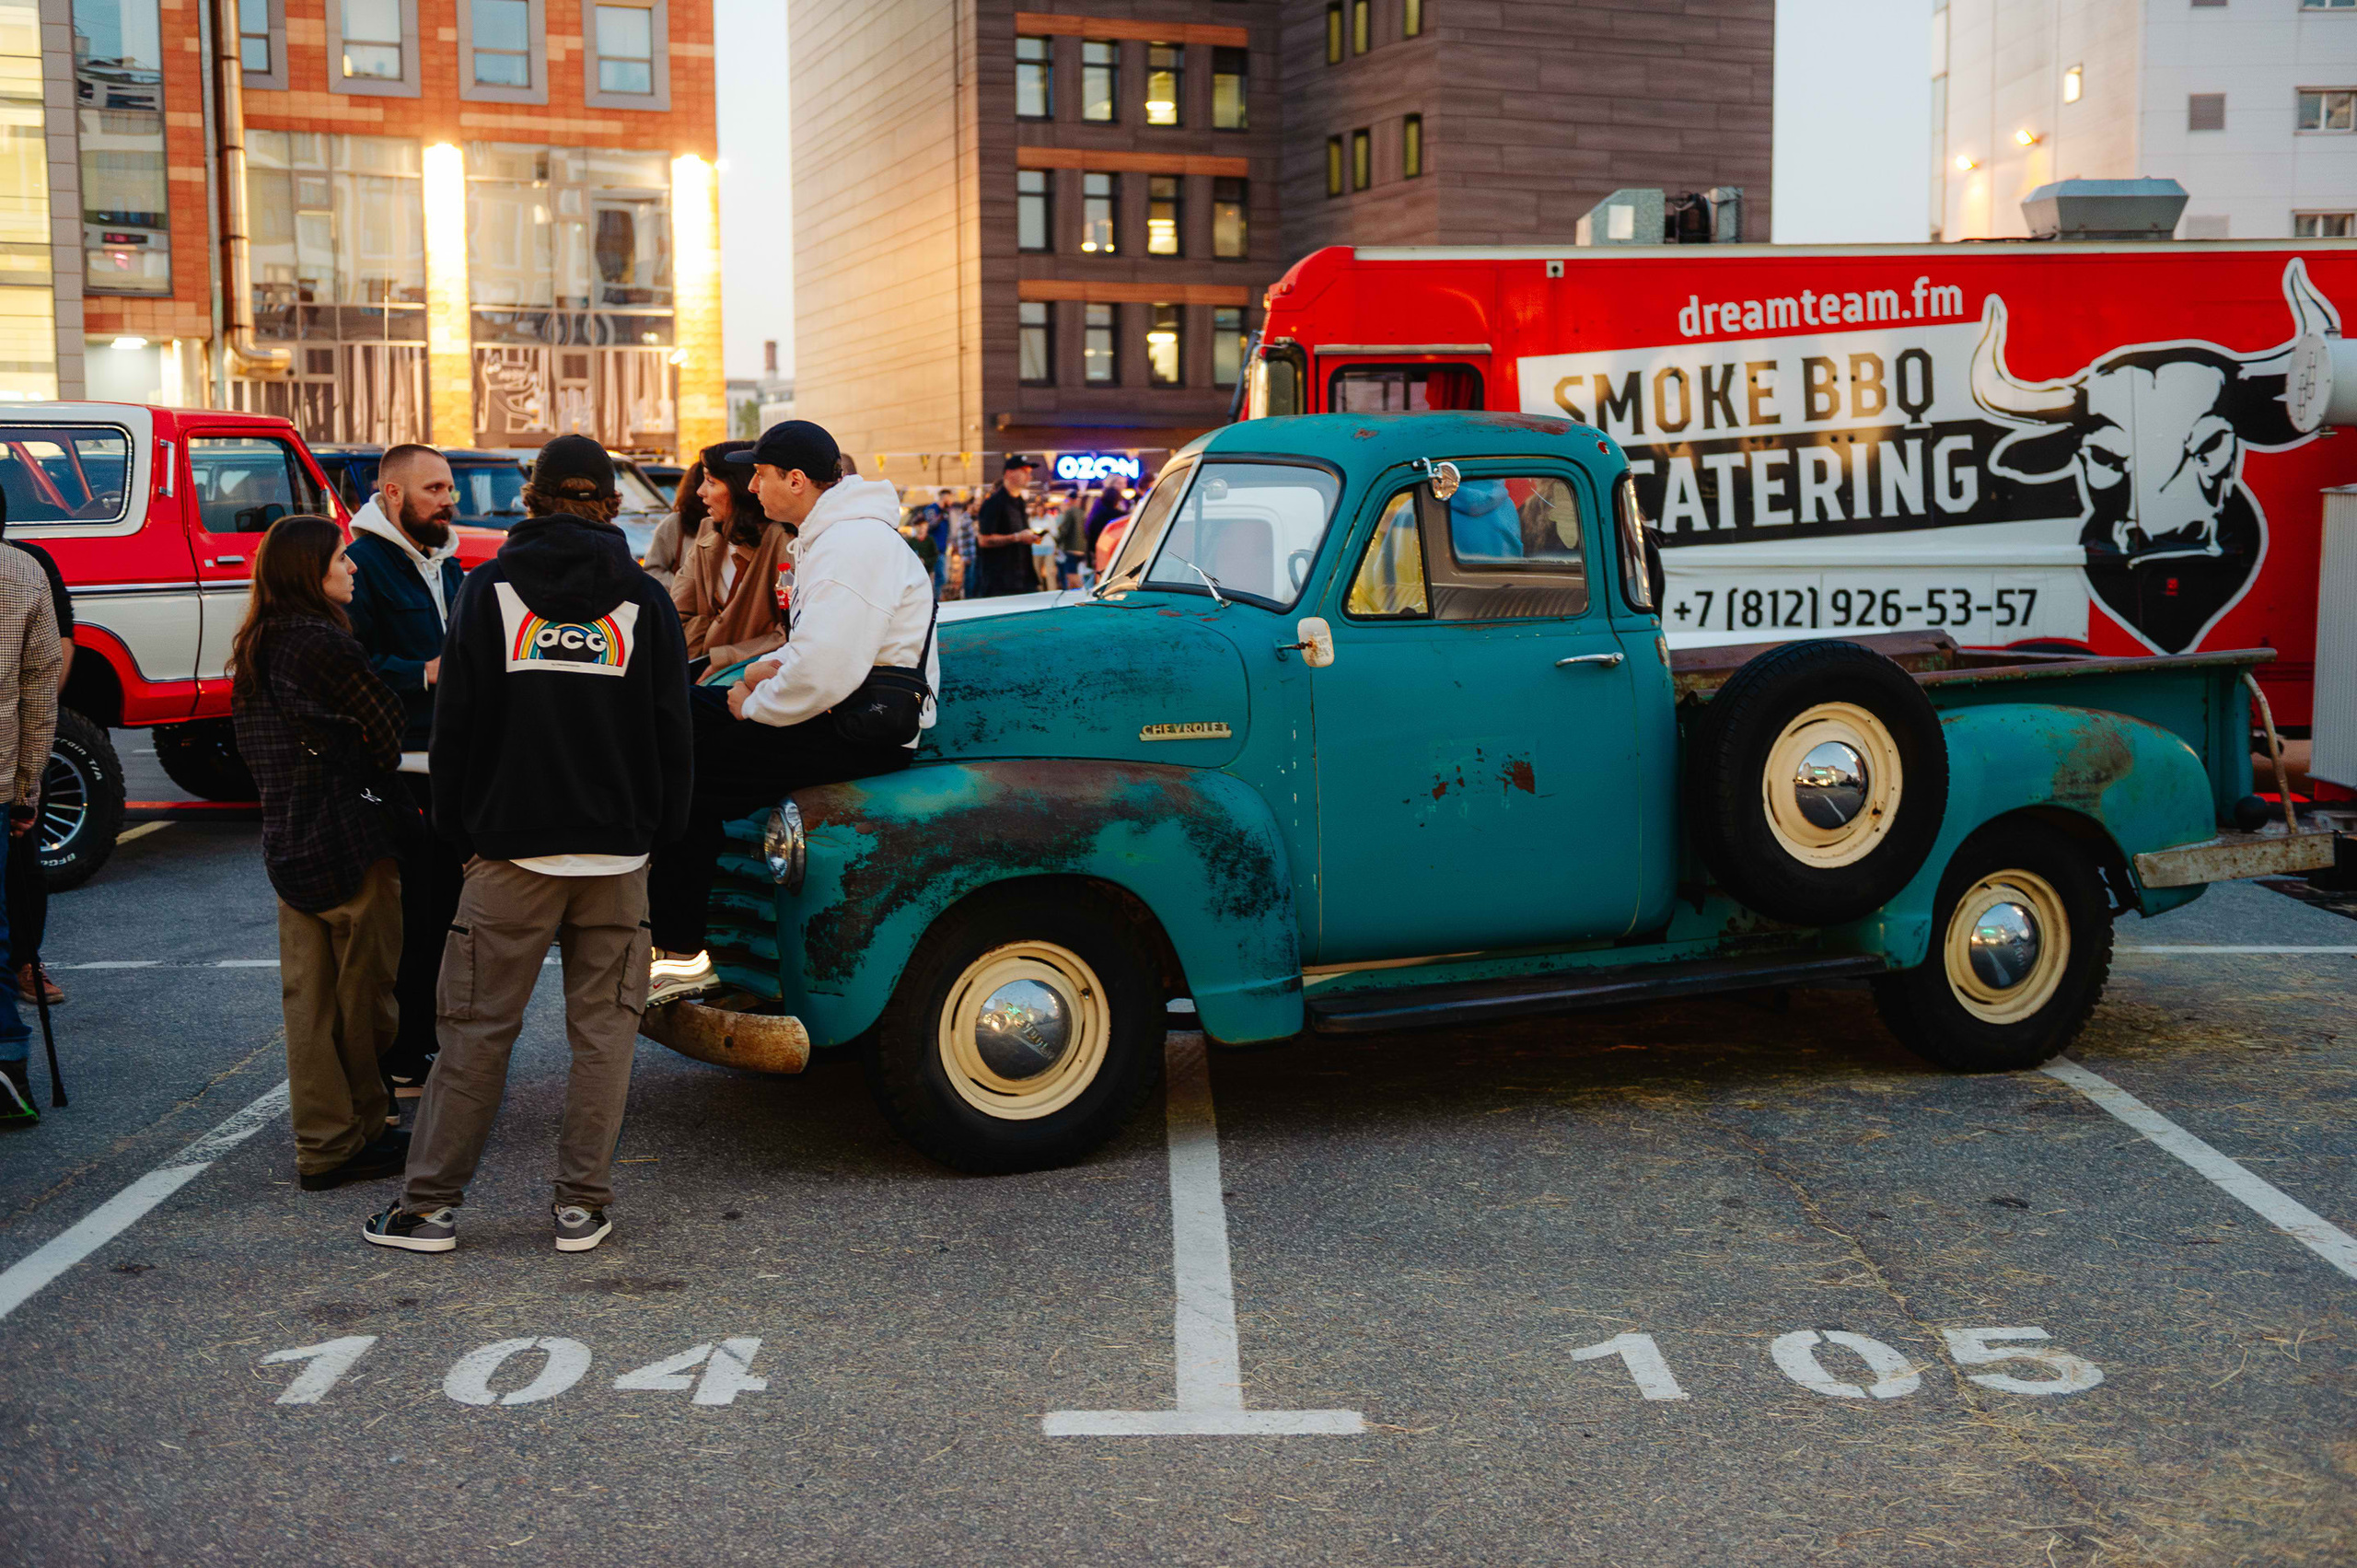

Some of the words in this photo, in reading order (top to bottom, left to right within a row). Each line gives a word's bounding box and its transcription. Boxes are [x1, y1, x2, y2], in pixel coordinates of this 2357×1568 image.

[1678, 276, 1964, 337] dreamteam.fm
[1553, 360, 1782, 436] SMOKE
[1801, 347, 1934, 430] BBQ
[1057, 455, 1140, 480] OZON
[1674, 590, 1714, 628] +7
[1727, 587, 1818, 631] (812)
[1831, 588, 2038, 627] 926-53-57
[1141, 722, 1230, 736] CHEVROLET
[261, 1335, 769, 1405] 104
[1569, 1326, 2105, 1400] 105
